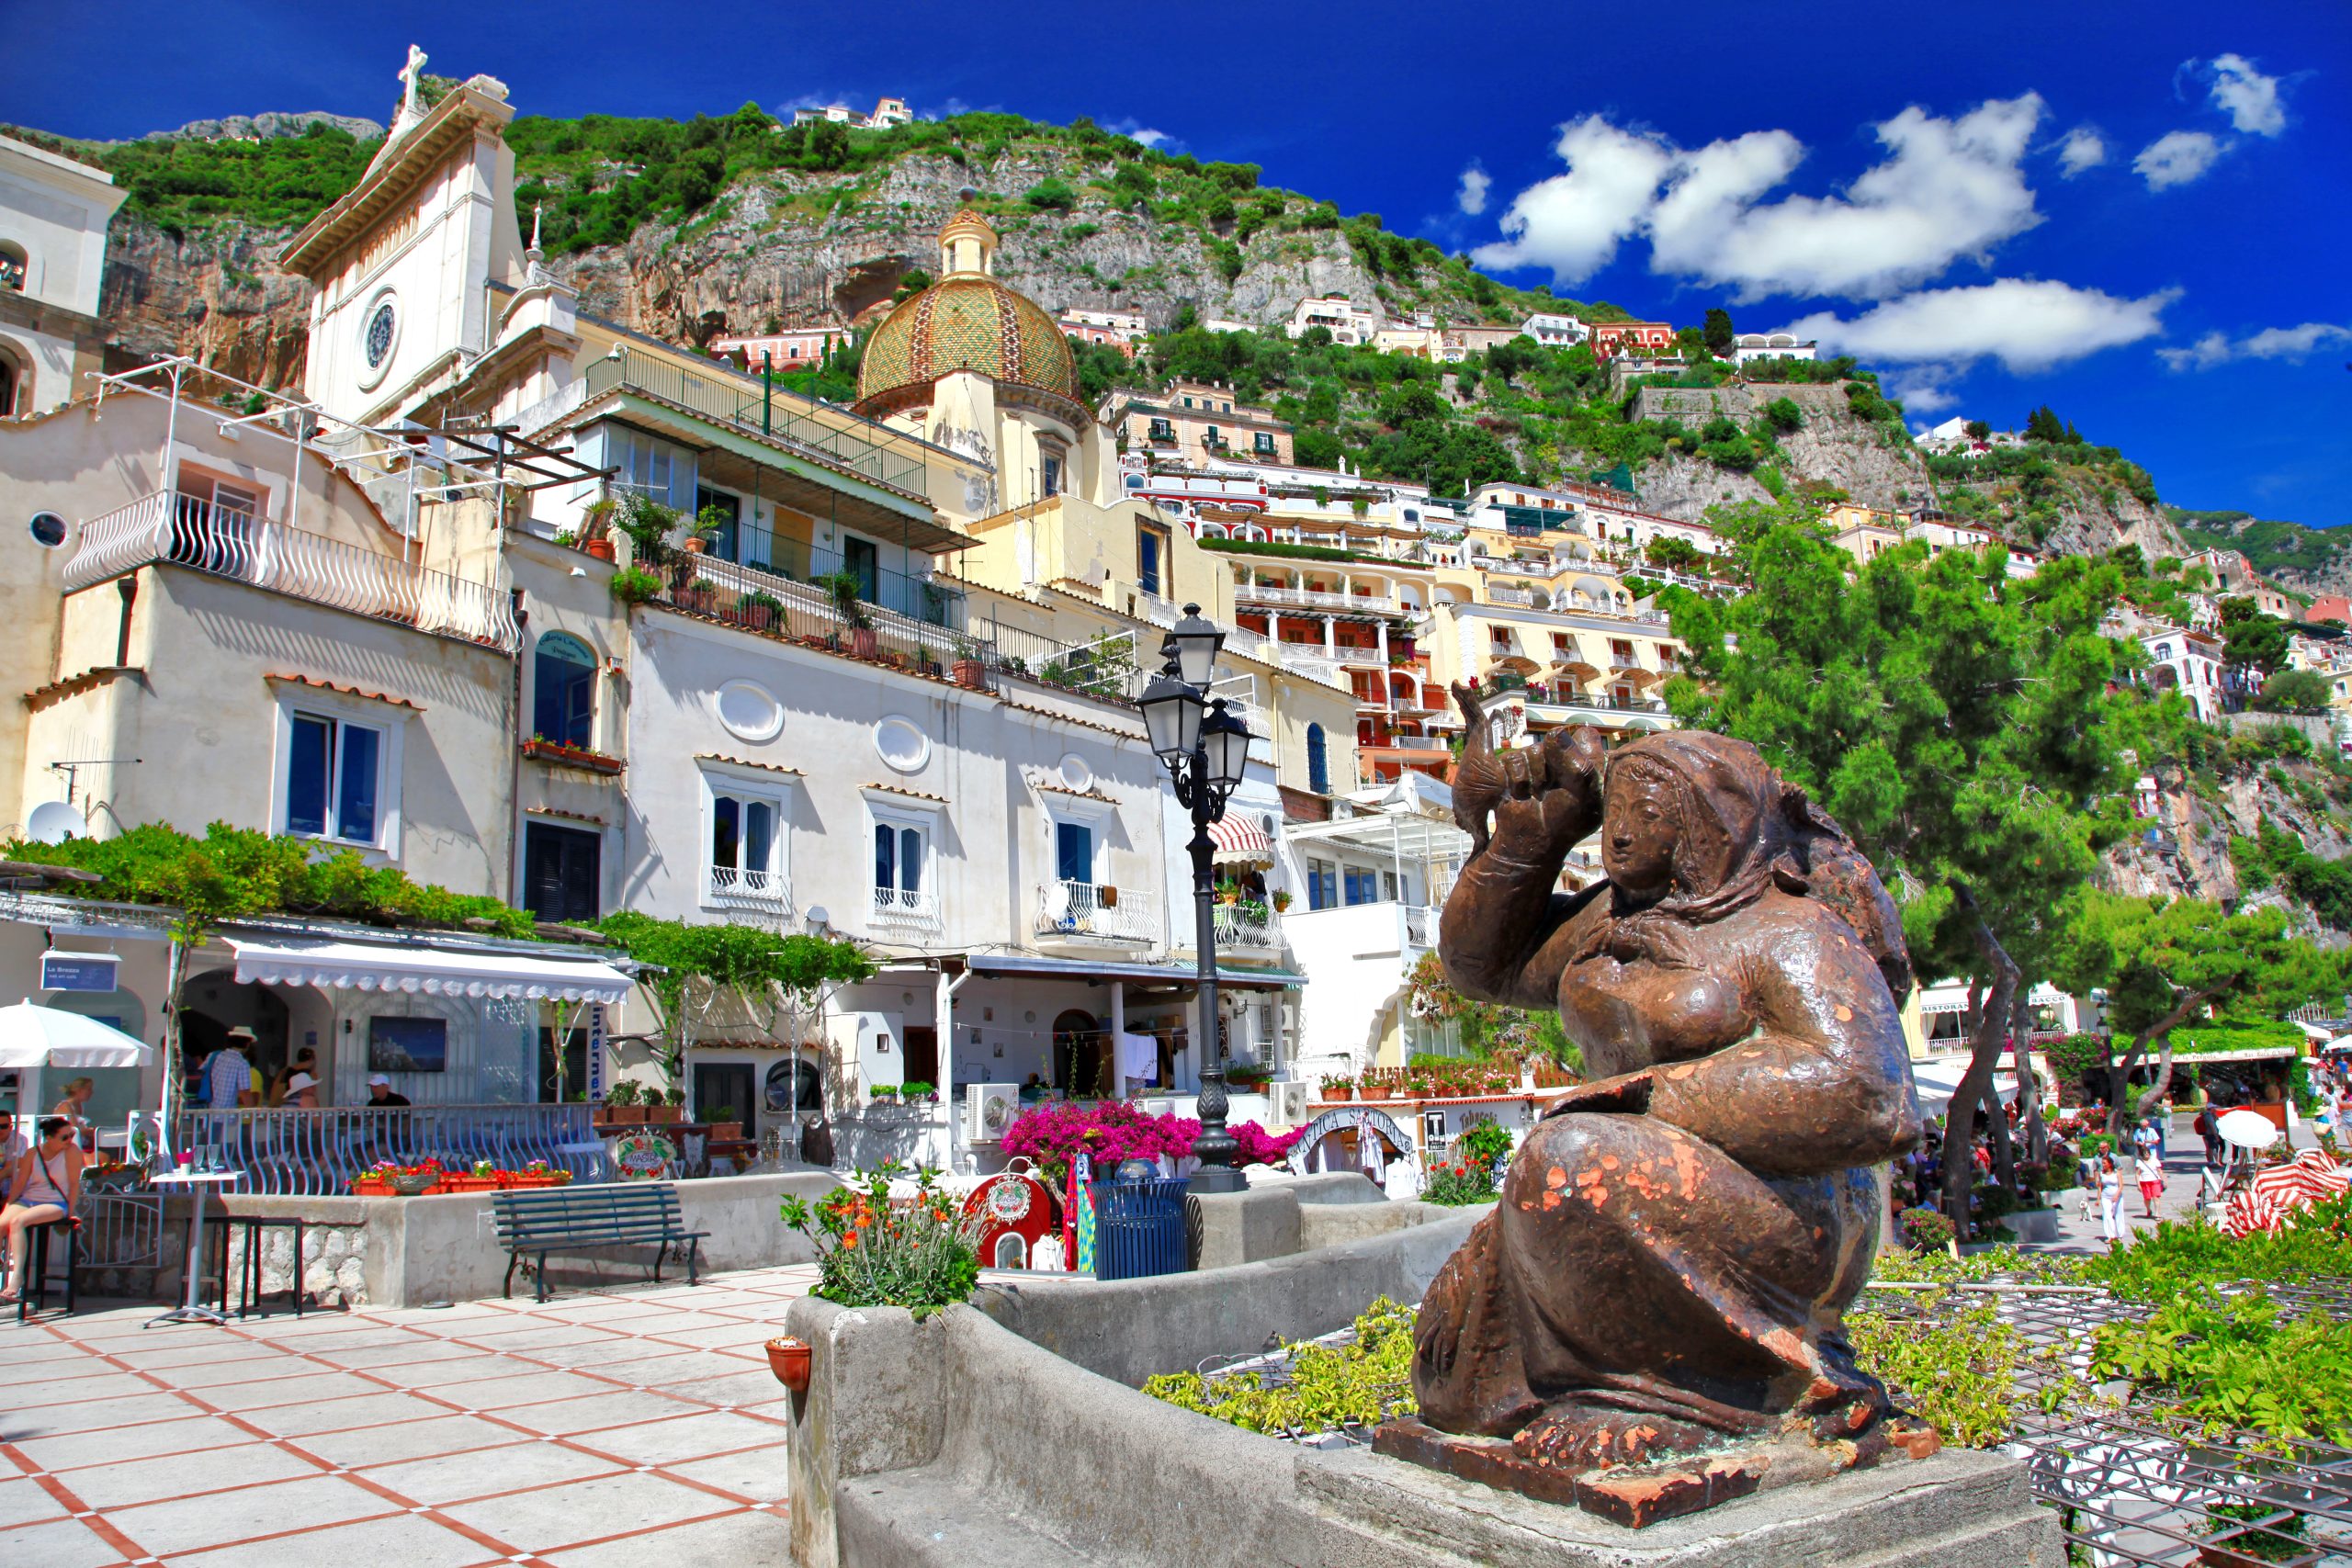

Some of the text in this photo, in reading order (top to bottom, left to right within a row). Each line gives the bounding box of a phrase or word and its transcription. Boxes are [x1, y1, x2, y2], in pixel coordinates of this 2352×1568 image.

[2031, 996, 2065, 1004] BACCO
[591, 1007, 604, 1100] internet
[1079, 1162, 1085, 1175] 5
